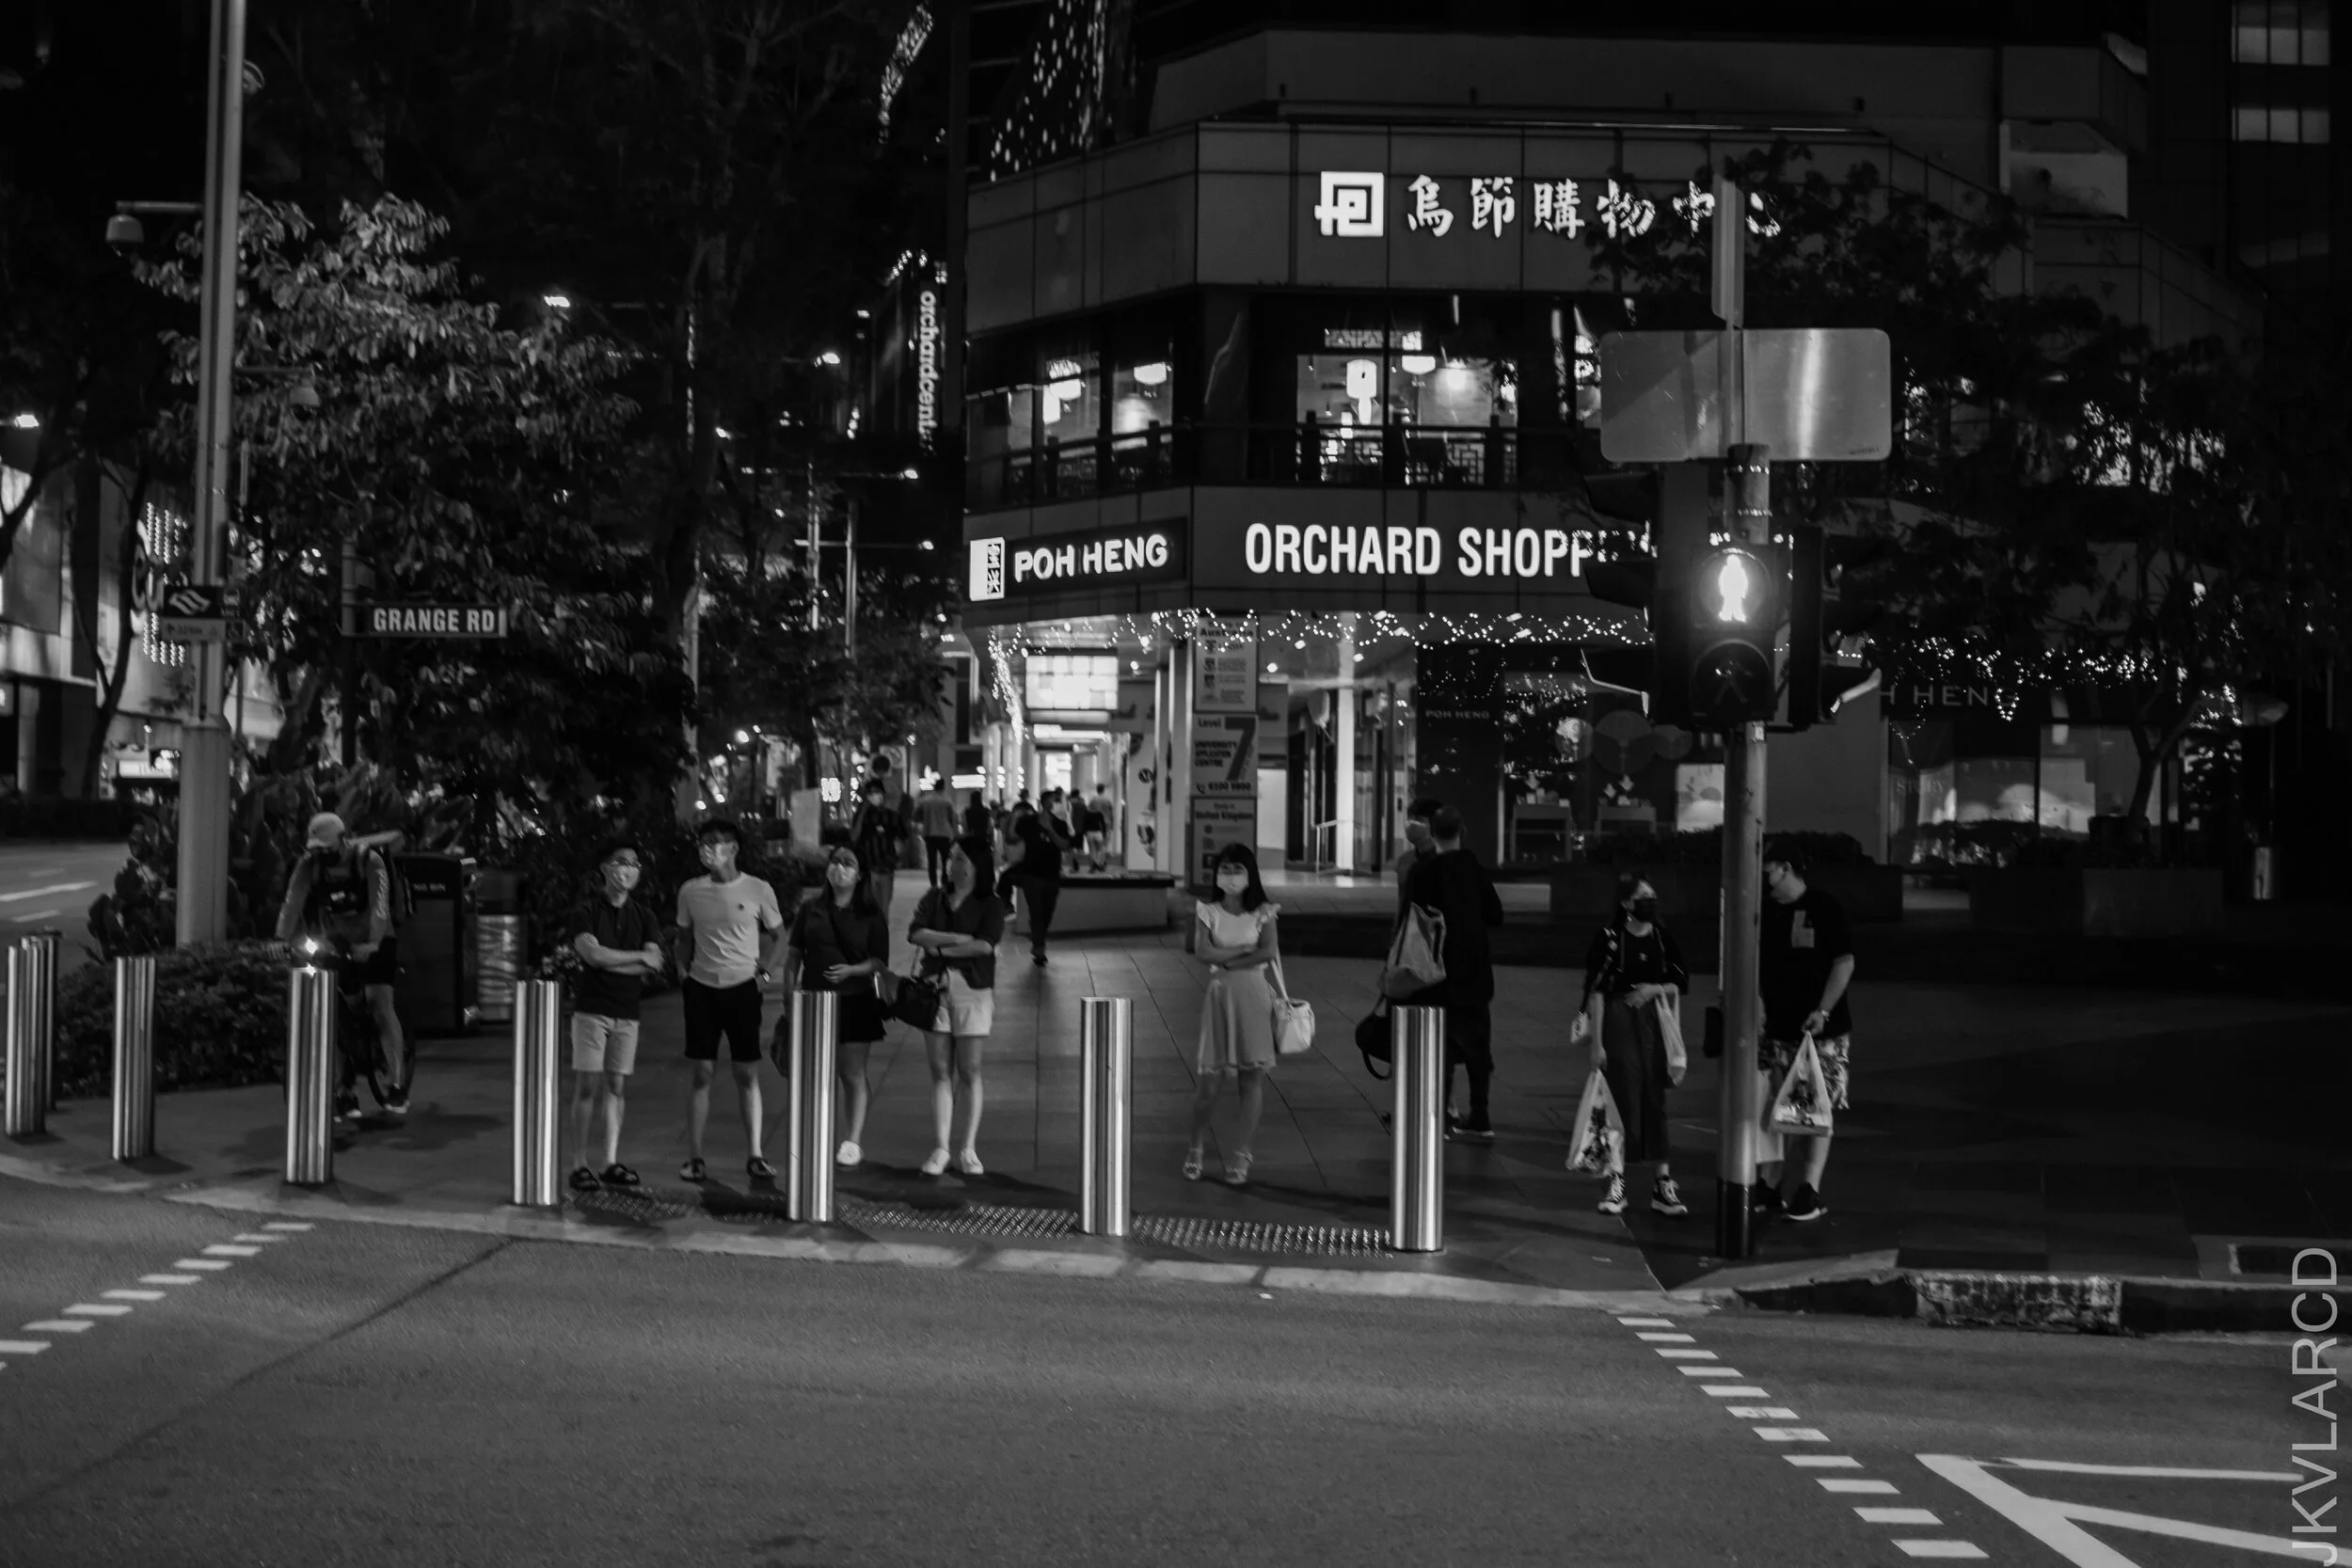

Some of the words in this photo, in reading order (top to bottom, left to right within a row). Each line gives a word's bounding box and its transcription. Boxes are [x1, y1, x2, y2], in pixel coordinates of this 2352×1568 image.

[1014, 544, 1076, 583] POH
[1083, 533, 1168, 575] HENG
[1245, 522, 1441, 575] ORCHARD
[374, 607, 459, 633] GRANGE
[467, 608, 495, 633] RD
[1424, 709, 1452, 720] POH
[1454, 709, 1490, 720] HENG
[1225, 717, 1257, 780] 7
